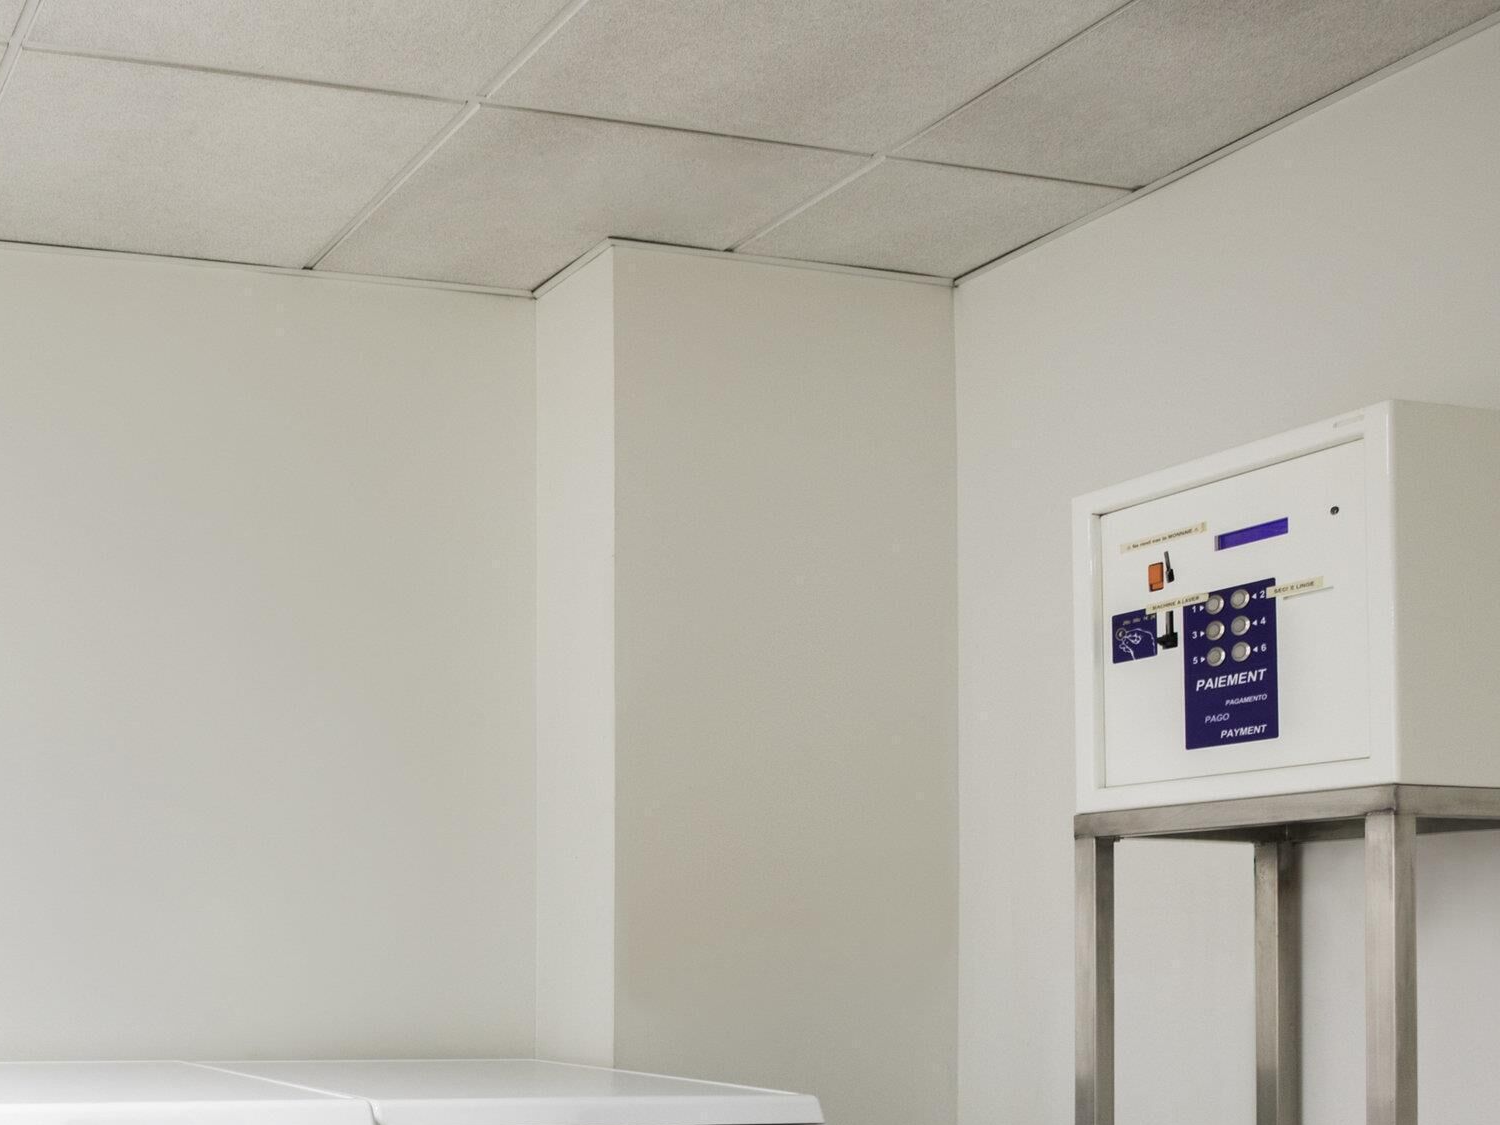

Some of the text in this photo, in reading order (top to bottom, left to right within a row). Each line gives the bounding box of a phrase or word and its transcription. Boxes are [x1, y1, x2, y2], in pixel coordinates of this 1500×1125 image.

[1259, 590, 1266, 599] 2
[1192, 605, 1197, 613] 1
[1260, 617, 1267, 625] 4
[1192, 631, 1198, 639] 3
[1260, 644, 1267, 652] 6
[1192, 656, 1199, 665] 5
[1195, 668, 1268, 692] PAIEMENT
[1225, 694, 1268, 706] PAGAMENTO
[1204, 712, 1230, 724] PAGO
[1220, 724, 1268, 739] PAYMENT
